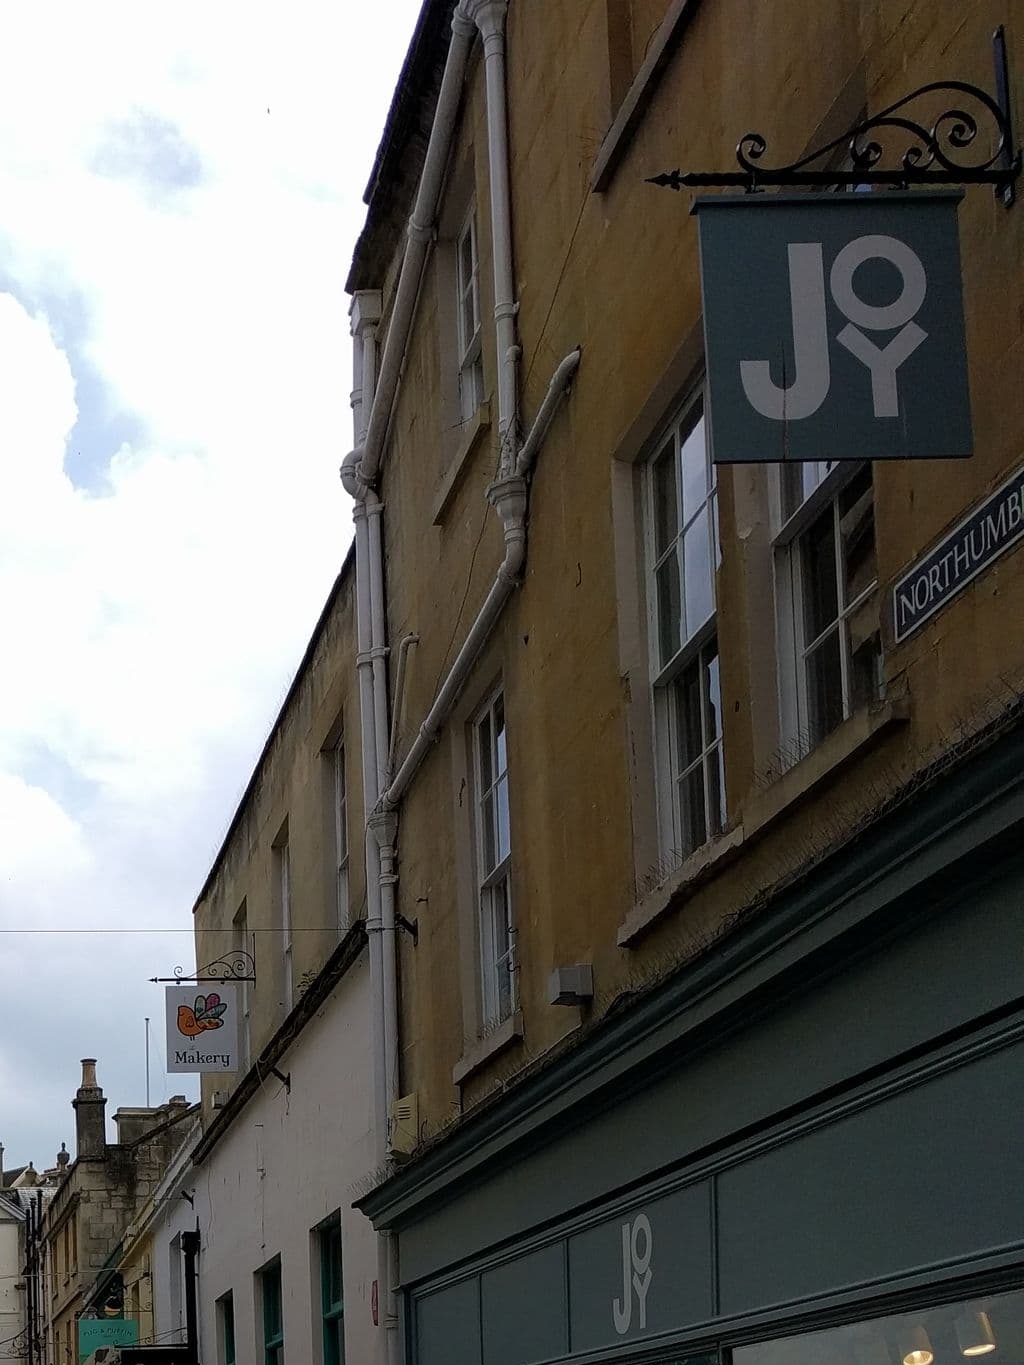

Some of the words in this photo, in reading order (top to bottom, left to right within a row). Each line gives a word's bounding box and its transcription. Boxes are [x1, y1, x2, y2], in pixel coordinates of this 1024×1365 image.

[739, 234, 929, 421] JOY
[174, 1050, 231, 1067] Makery
[612, 1213, 654, 1335] JOY
